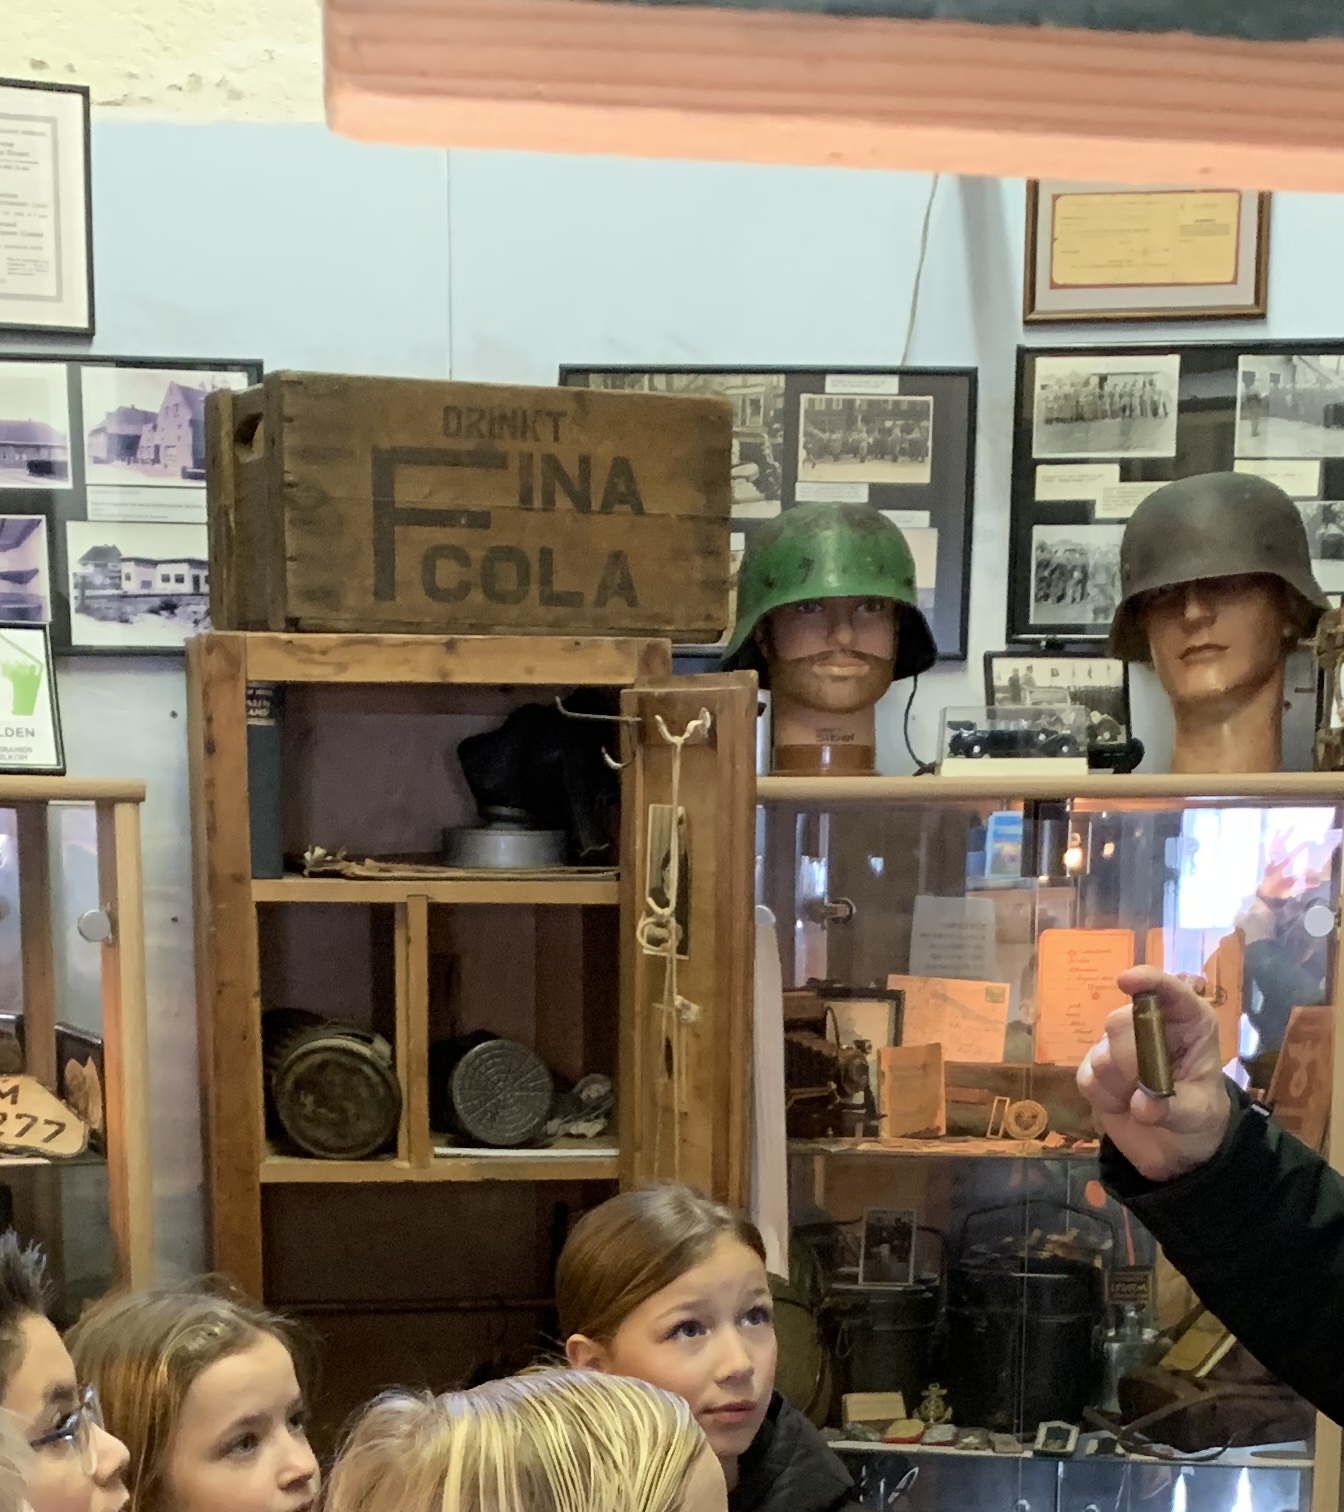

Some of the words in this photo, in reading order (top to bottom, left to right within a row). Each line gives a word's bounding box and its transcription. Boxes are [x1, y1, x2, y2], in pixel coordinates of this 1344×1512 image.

[442, 405, 568, 443] DRINKT
[371, 445, 646, 602] FINA
[421, 543, 639, 608] COLA
